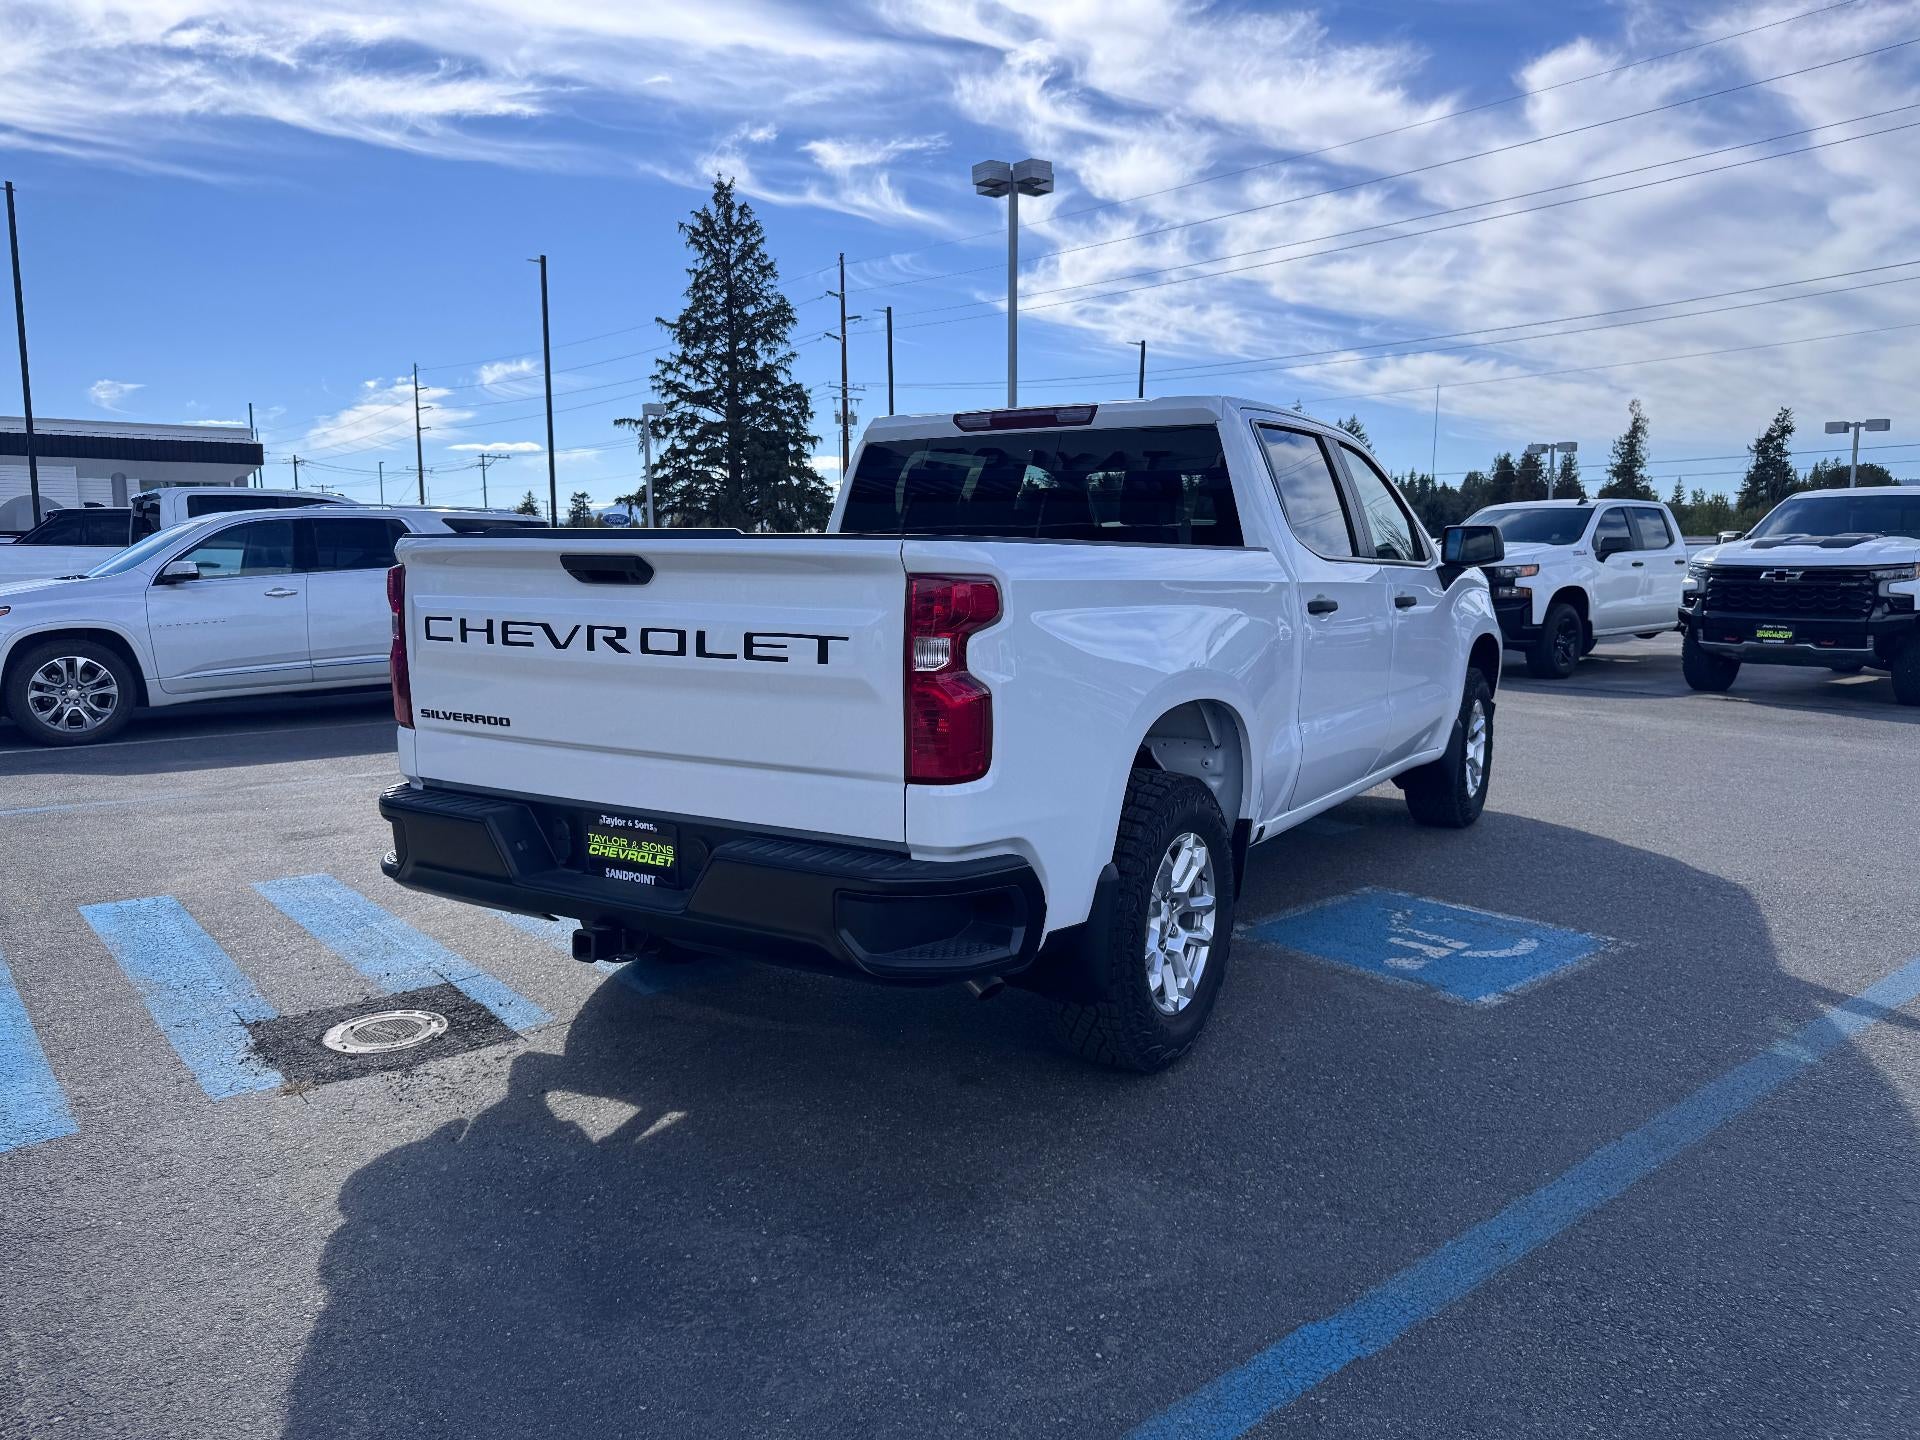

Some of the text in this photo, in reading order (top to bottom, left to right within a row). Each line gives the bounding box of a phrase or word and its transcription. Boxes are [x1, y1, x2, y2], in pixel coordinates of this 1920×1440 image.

[424, 616, 850, 665] CHEVROLET
[420, 709, 511, 727] SILVERADO
[601, 815, 626, 827] Taylor
[635, 820, 654, 831] Sons
[588, 833, 674, 855] TAYLOR & SONS
[588, 844, 675, 867] CHEVROLET
[605, 868, 656, 886] SANDPOINT
